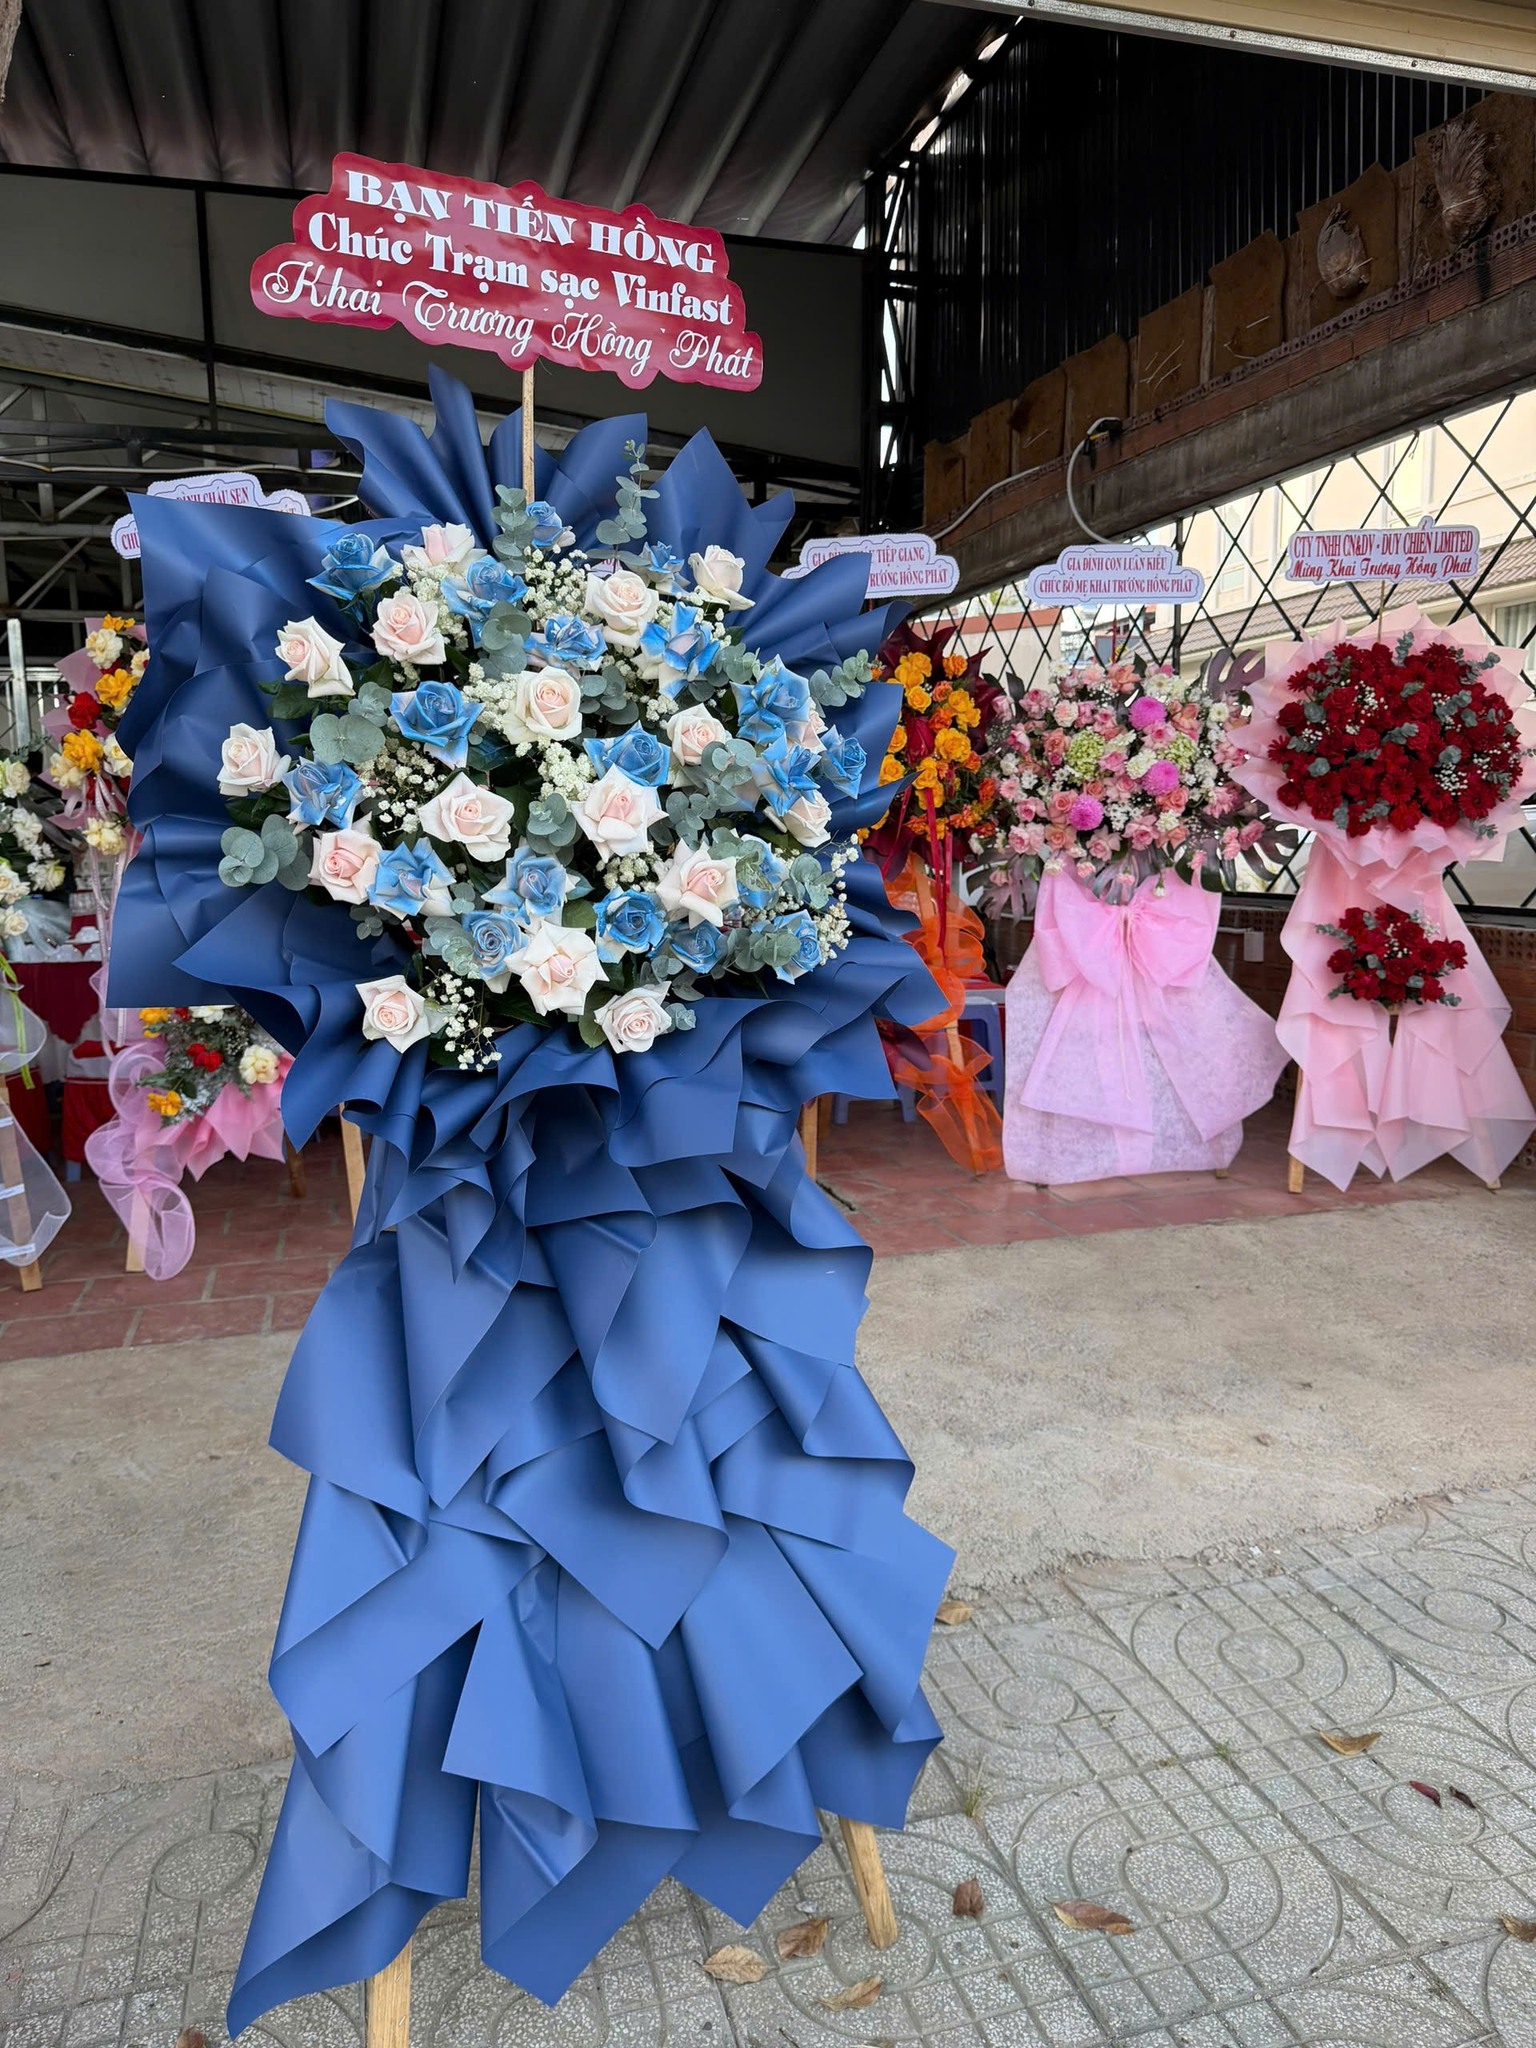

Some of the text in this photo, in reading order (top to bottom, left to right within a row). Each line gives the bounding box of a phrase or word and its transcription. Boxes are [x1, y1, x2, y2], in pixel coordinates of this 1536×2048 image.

[345, 169, 718, 274] BẠN TIẾN HỒNG
[308, 211, 734, 326] Chúc Trạm sạc Vinfast
[262, 260, 755, 379] Khai Trương Hồng Phát
[1290, 558, 1323, 581] Mừng
[1326, 558, 1357, 578] Khai
[1359, 556, 1402, 580] Trương
[1440, 554, 1473, 578] Phát
[1294, 536, 1313, 558] CTY
[1315, 534, 1342, 558] TNHH
[1381, 532, 1403, 555] DUY
[1434, 530, 1473, 553] LIMITED
[870, 568, 898, 587] RƯƠNG
